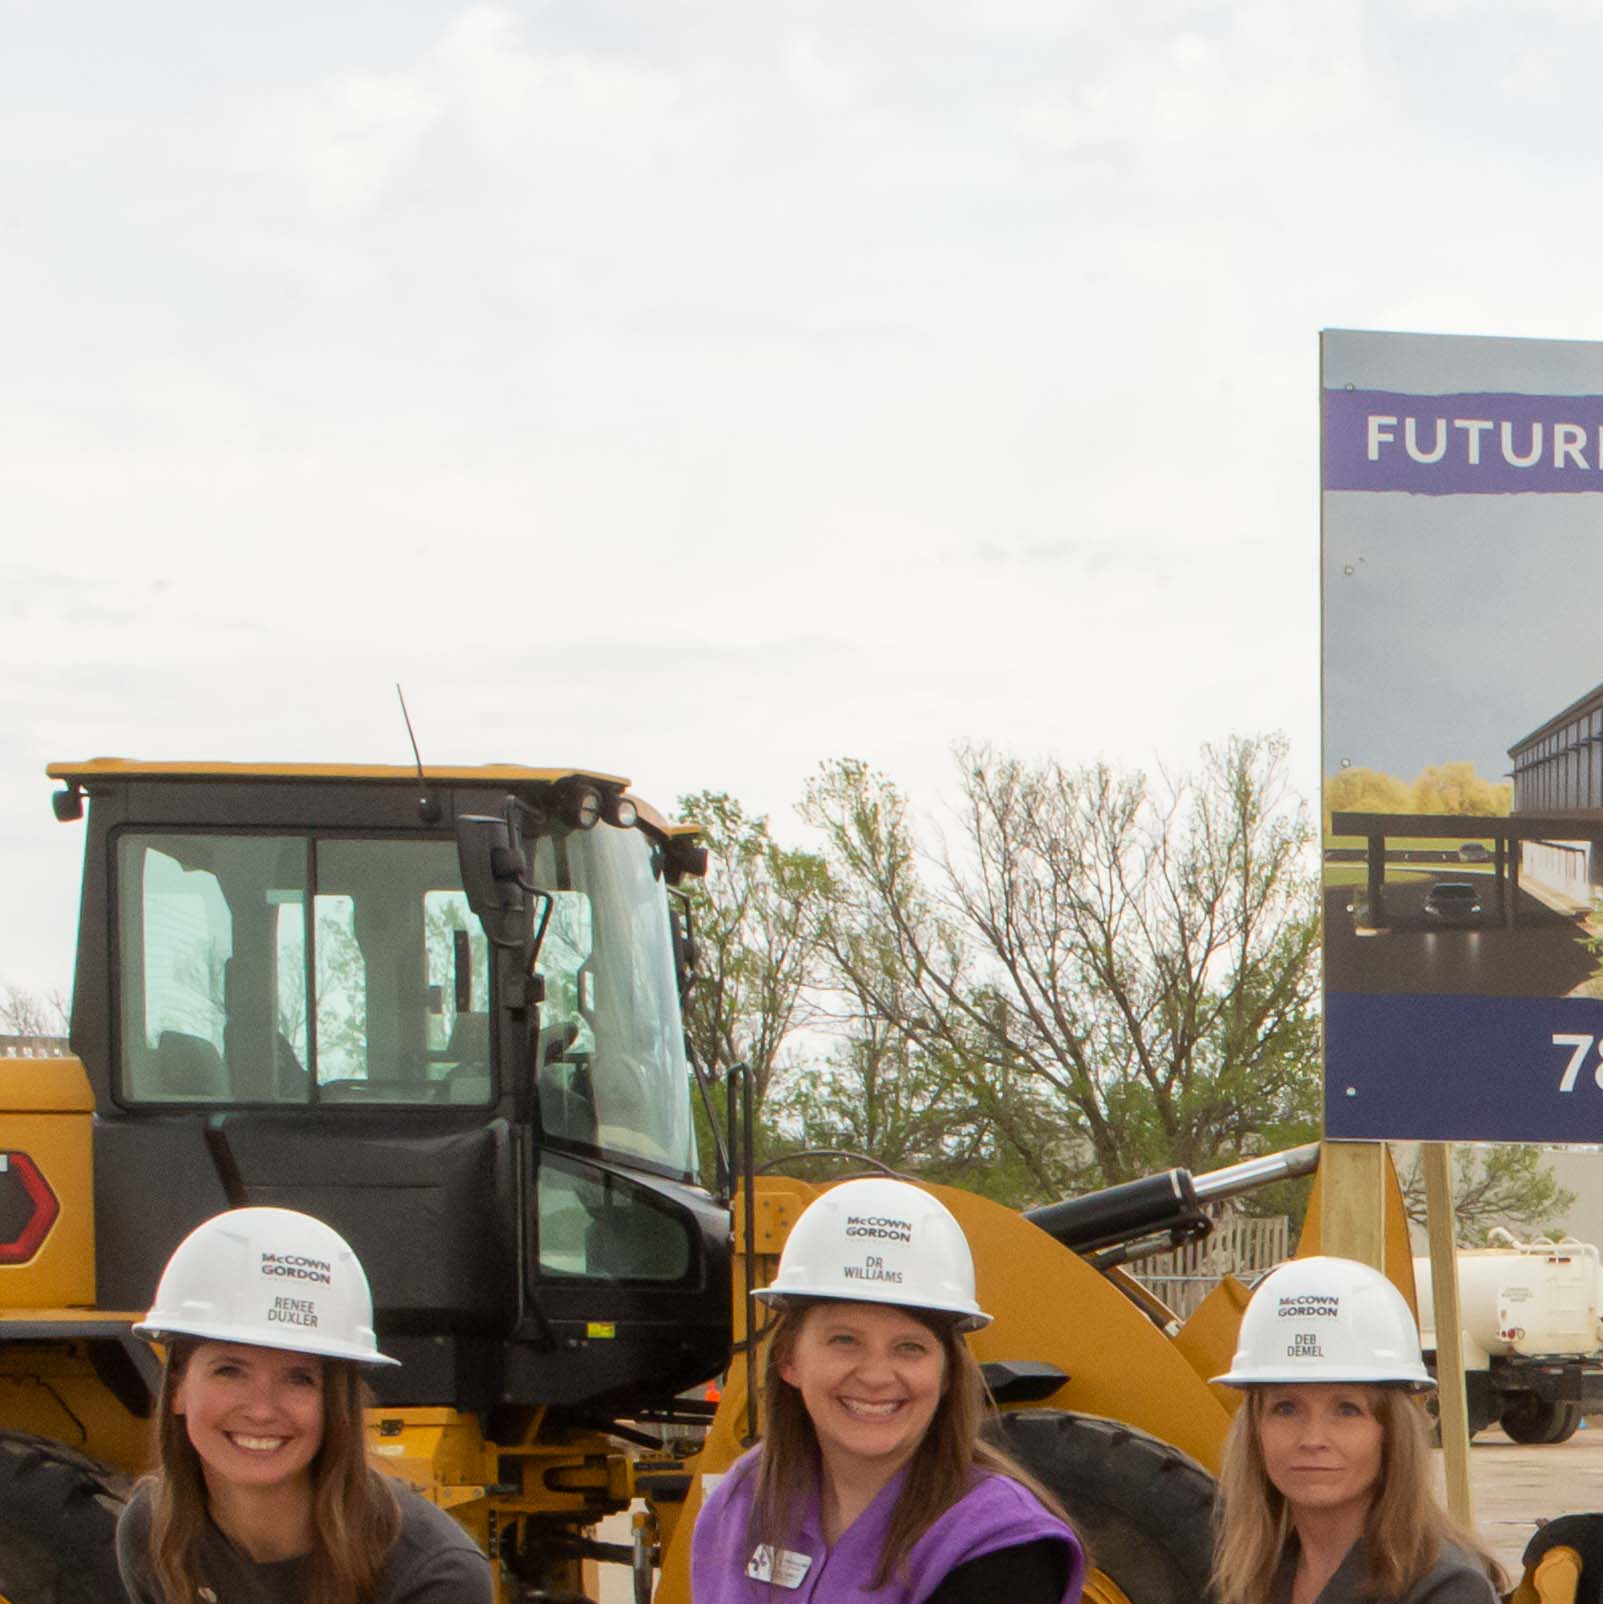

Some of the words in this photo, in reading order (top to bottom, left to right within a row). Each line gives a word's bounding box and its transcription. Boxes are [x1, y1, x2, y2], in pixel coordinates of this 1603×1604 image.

[847, 1215, 912, 1231] McCOWN
[845, 1226, 911, 1243] GORDON
[261, 1252, 331, 1273] McCOWN
[865, 1255, 884, 1269] DR
[261, 1264, 331, 1285] GORDON
[843, 1265, 903, 1284] WILLIAMS
[274, 1295, 316, 1314] RENEE
[1278, 1295, 1340, 1306] McCOWN
[267, 1308, 319, 1329] DUXLER
[1277, 1306, 1339, 1318] GORDON
[1294, 1333, 1317, 1345] DEB
[1286, 1345, 1325, 1358] DEMEL
